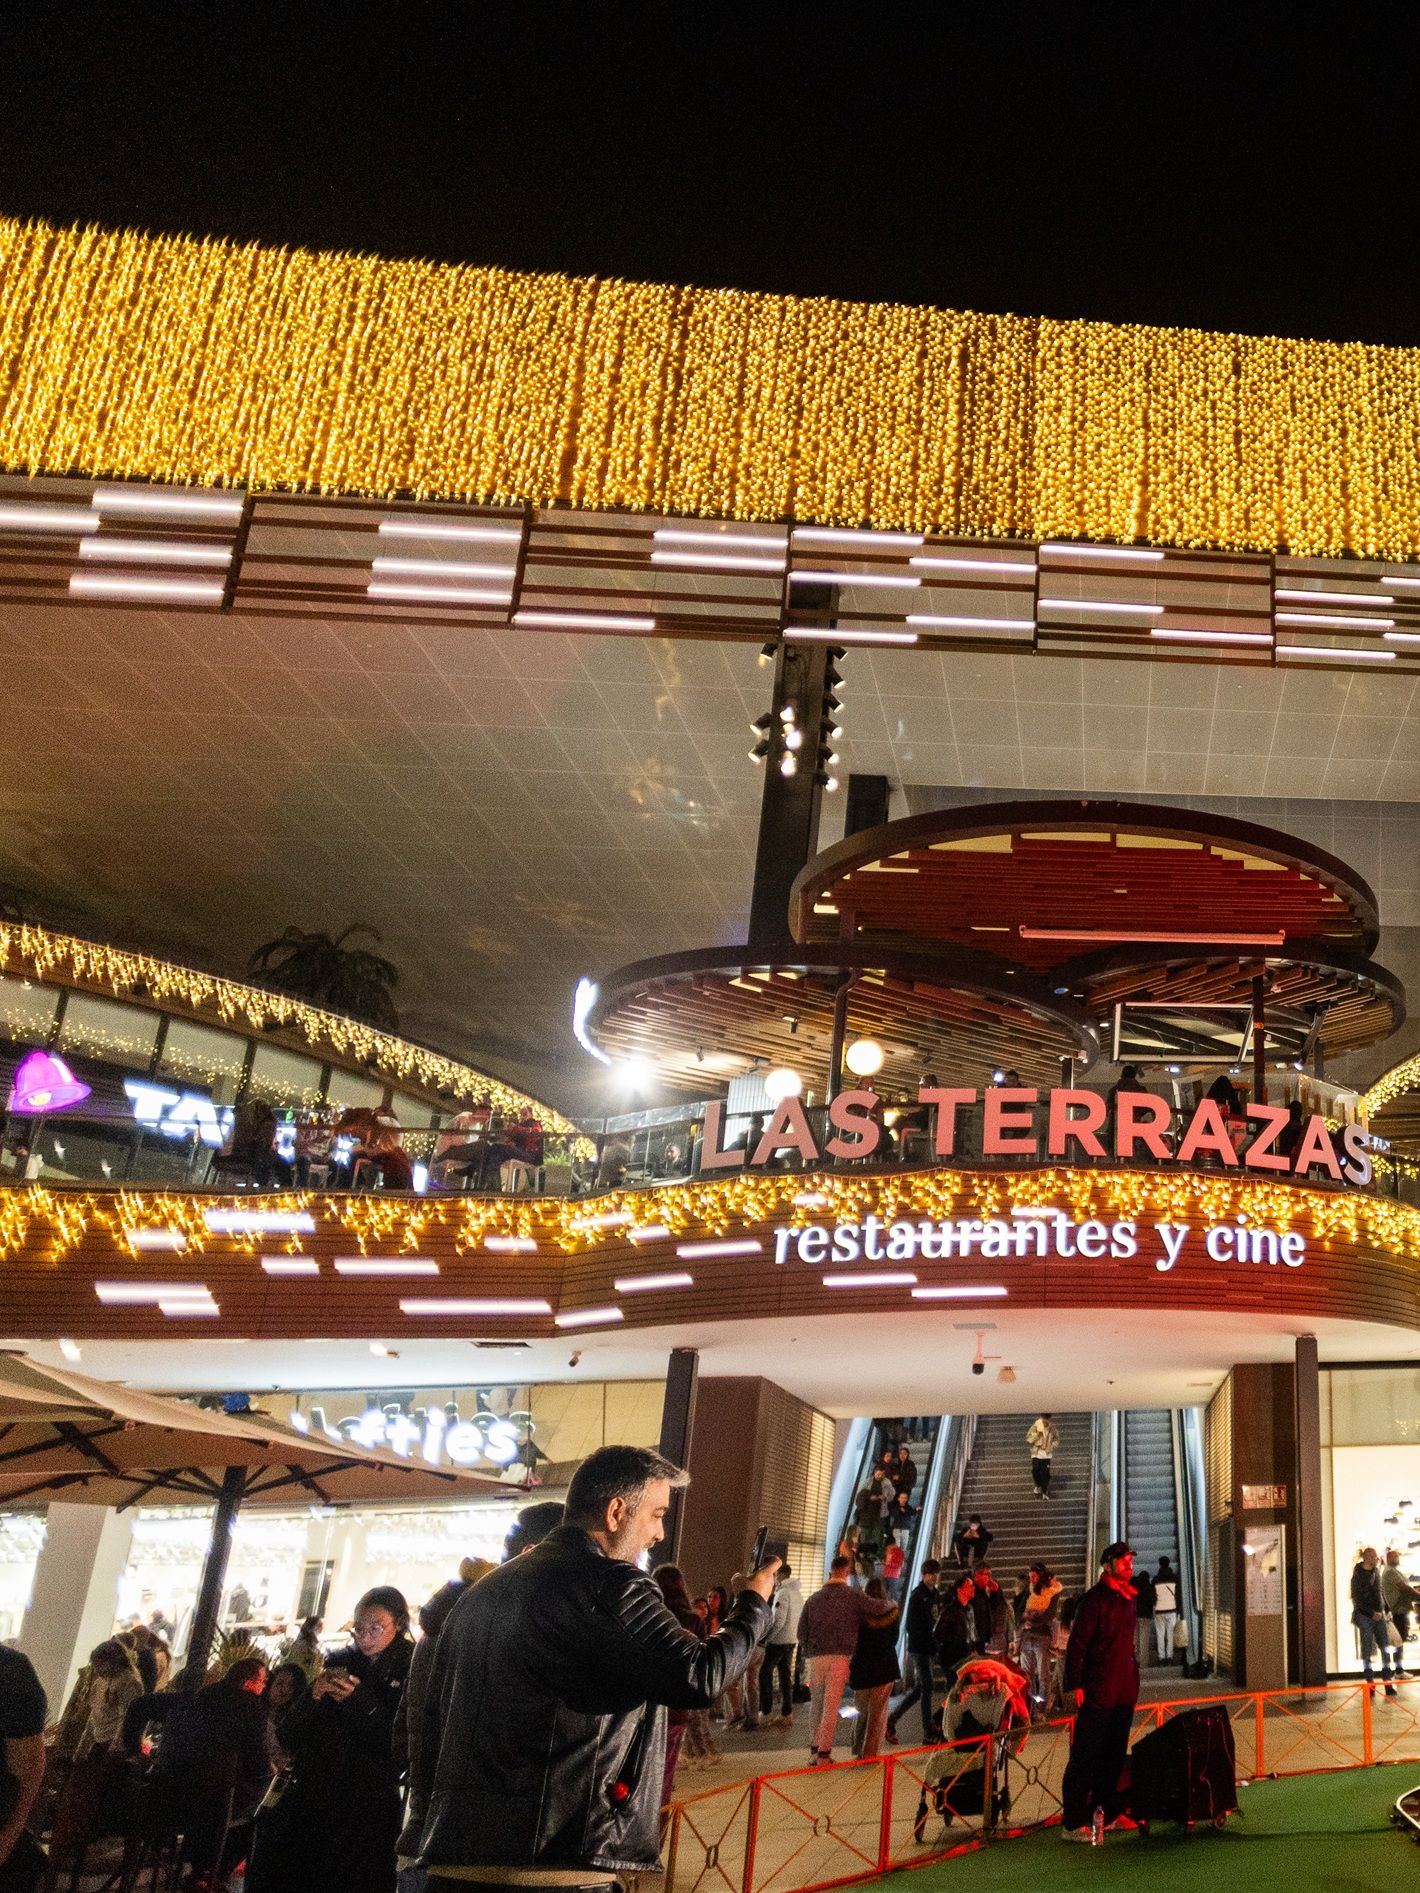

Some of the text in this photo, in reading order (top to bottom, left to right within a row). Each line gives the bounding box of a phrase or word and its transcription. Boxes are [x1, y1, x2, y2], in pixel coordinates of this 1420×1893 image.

[122, 1081, 235, 1147] TA
[700, 1089, 880, 1170] LAS
[918, 1088, 1373, 1186] TERRAZAS
[773, 1214, 1306, 1272] restaurantes y cine
